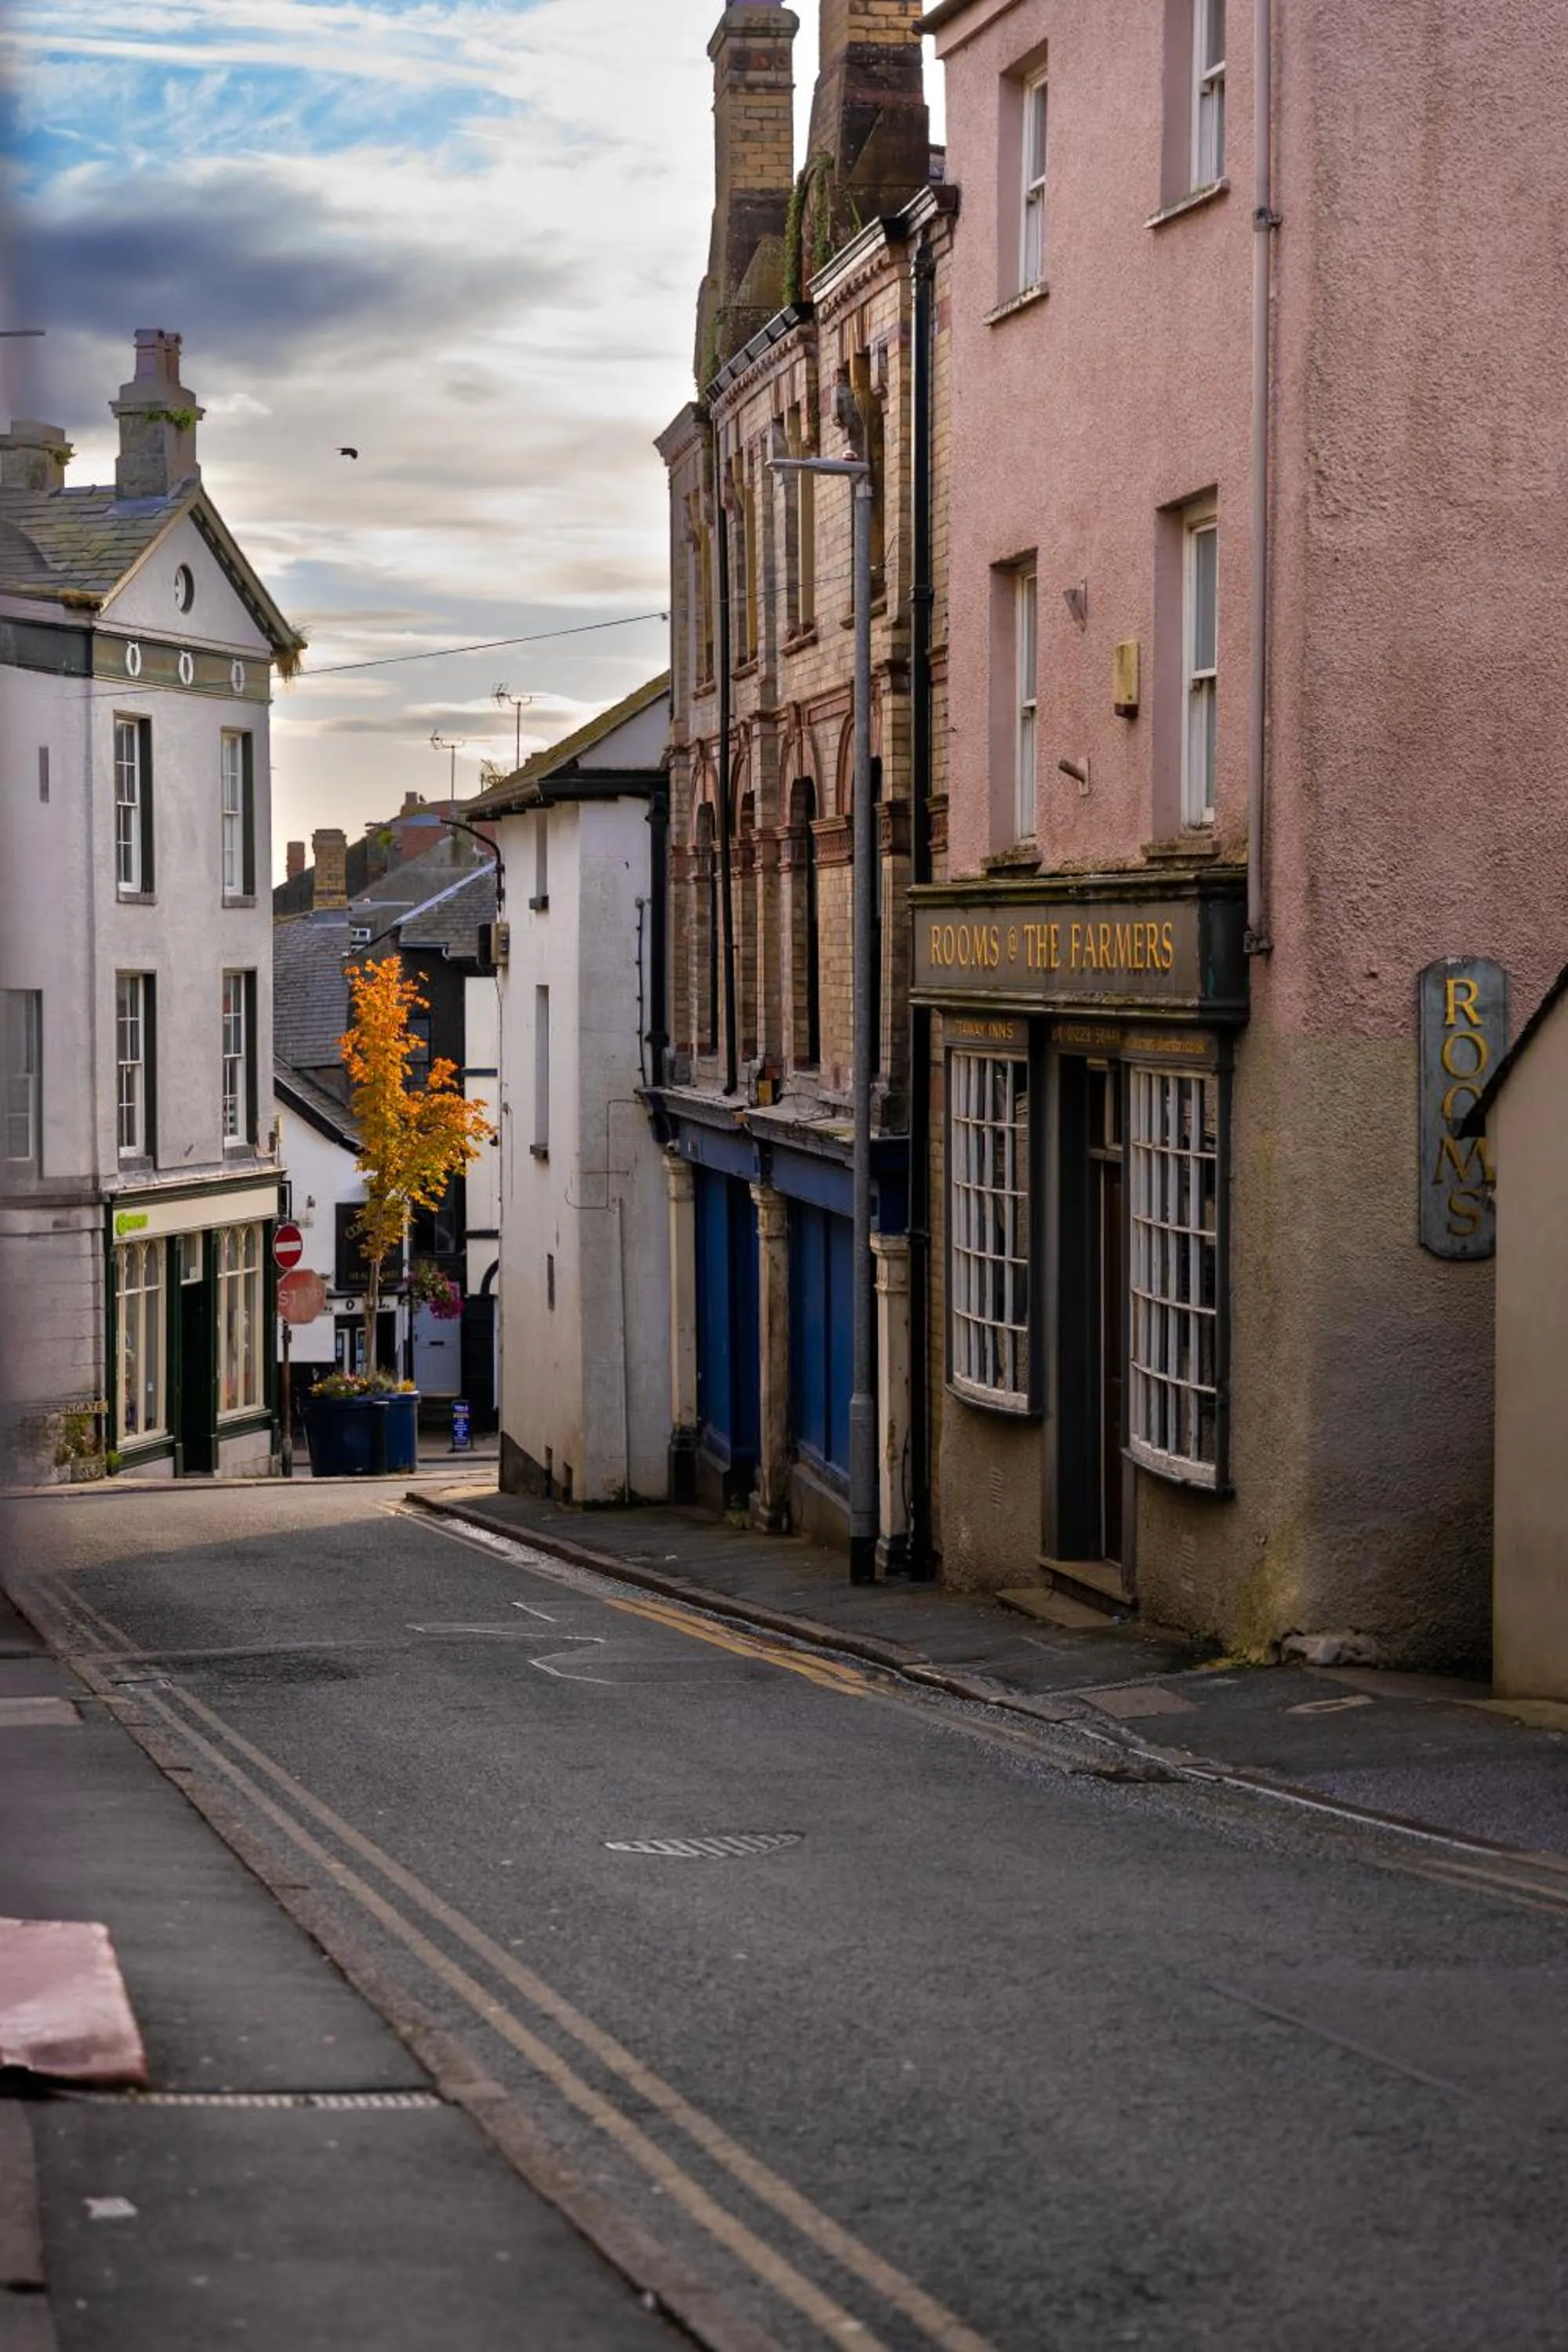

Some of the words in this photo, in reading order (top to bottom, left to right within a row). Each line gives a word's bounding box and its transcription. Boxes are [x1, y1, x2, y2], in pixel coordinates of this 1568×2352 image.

[931, 925, 1000, 966] ROOMS
[1024, 924, 1060, 967] THE
[1070, 922, 1173, 969] FARMERS
[988, 1022, 1014, 1040] INNS
